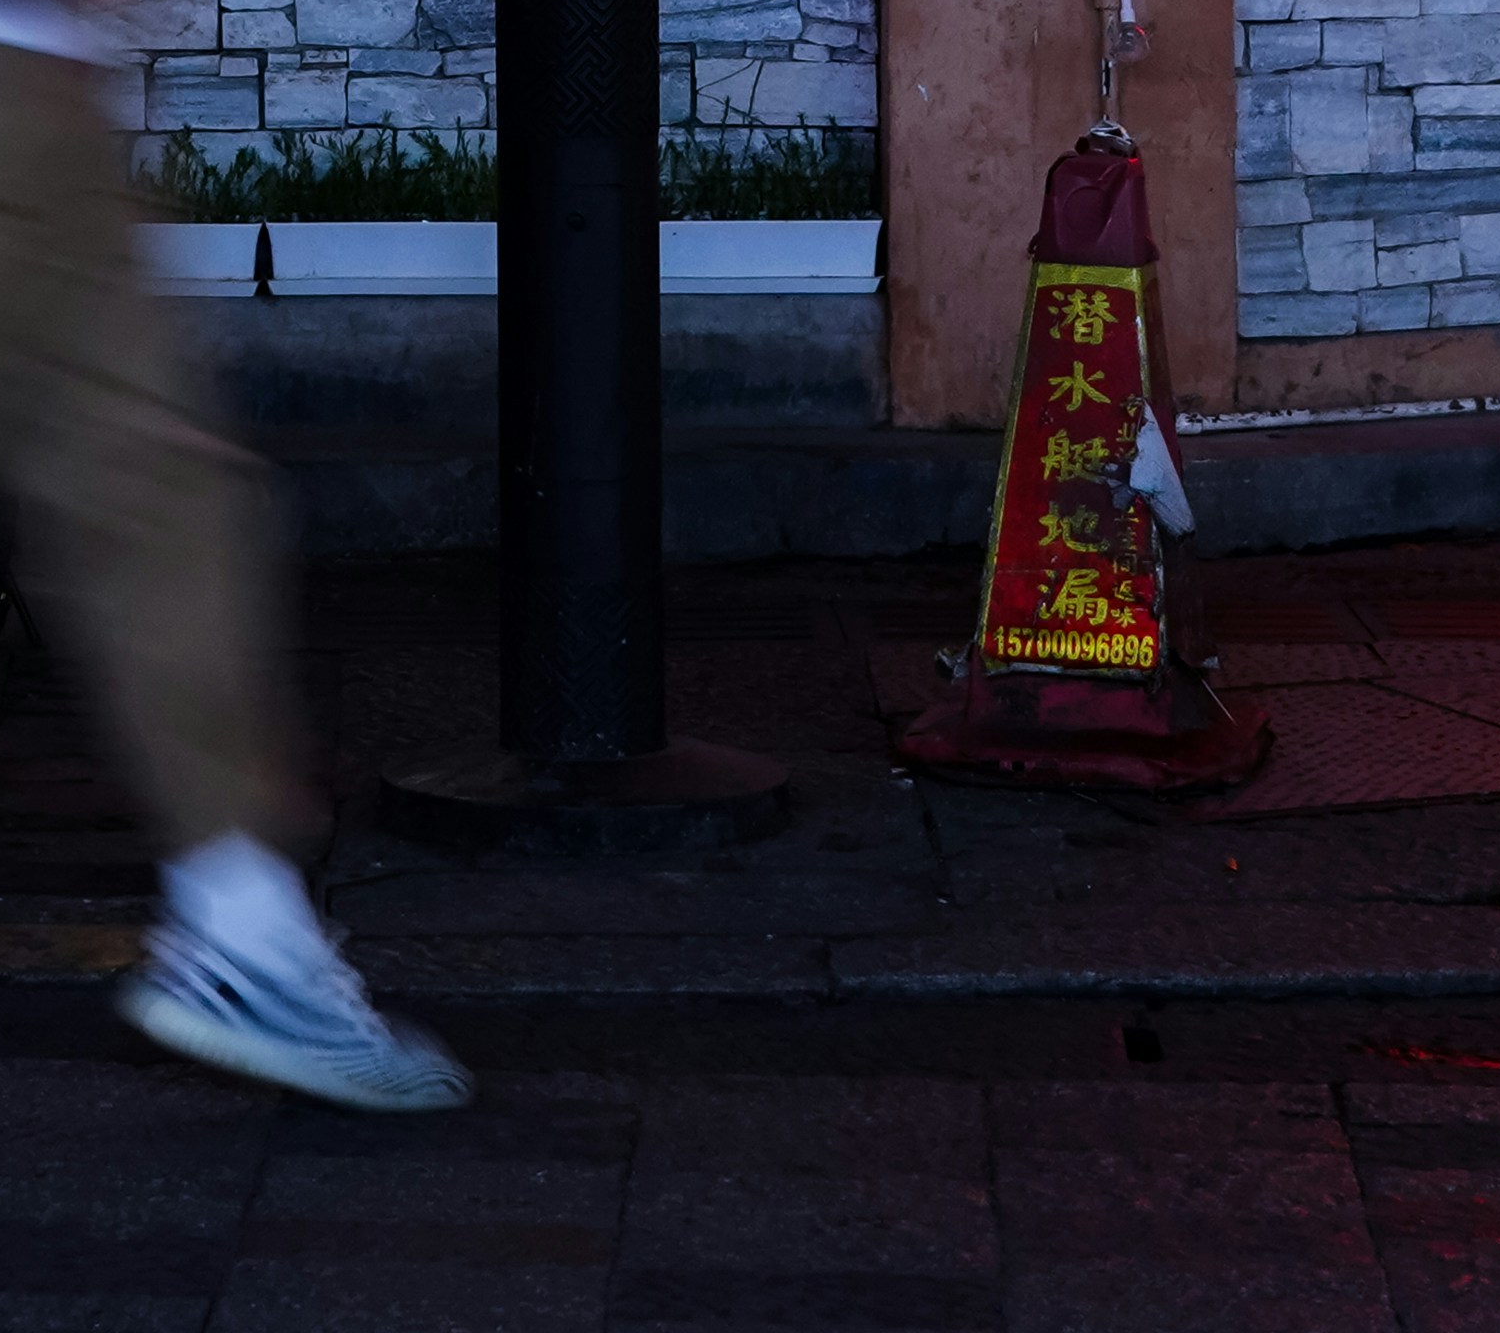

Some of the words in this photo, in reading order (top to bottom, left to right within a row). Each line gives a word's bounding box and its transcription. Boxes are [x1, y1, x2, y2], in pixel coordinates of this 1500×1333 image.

[1039, 290, 1118, 626] 潜水艇地漏
[992, 625, 1155, 668] 15700096896
